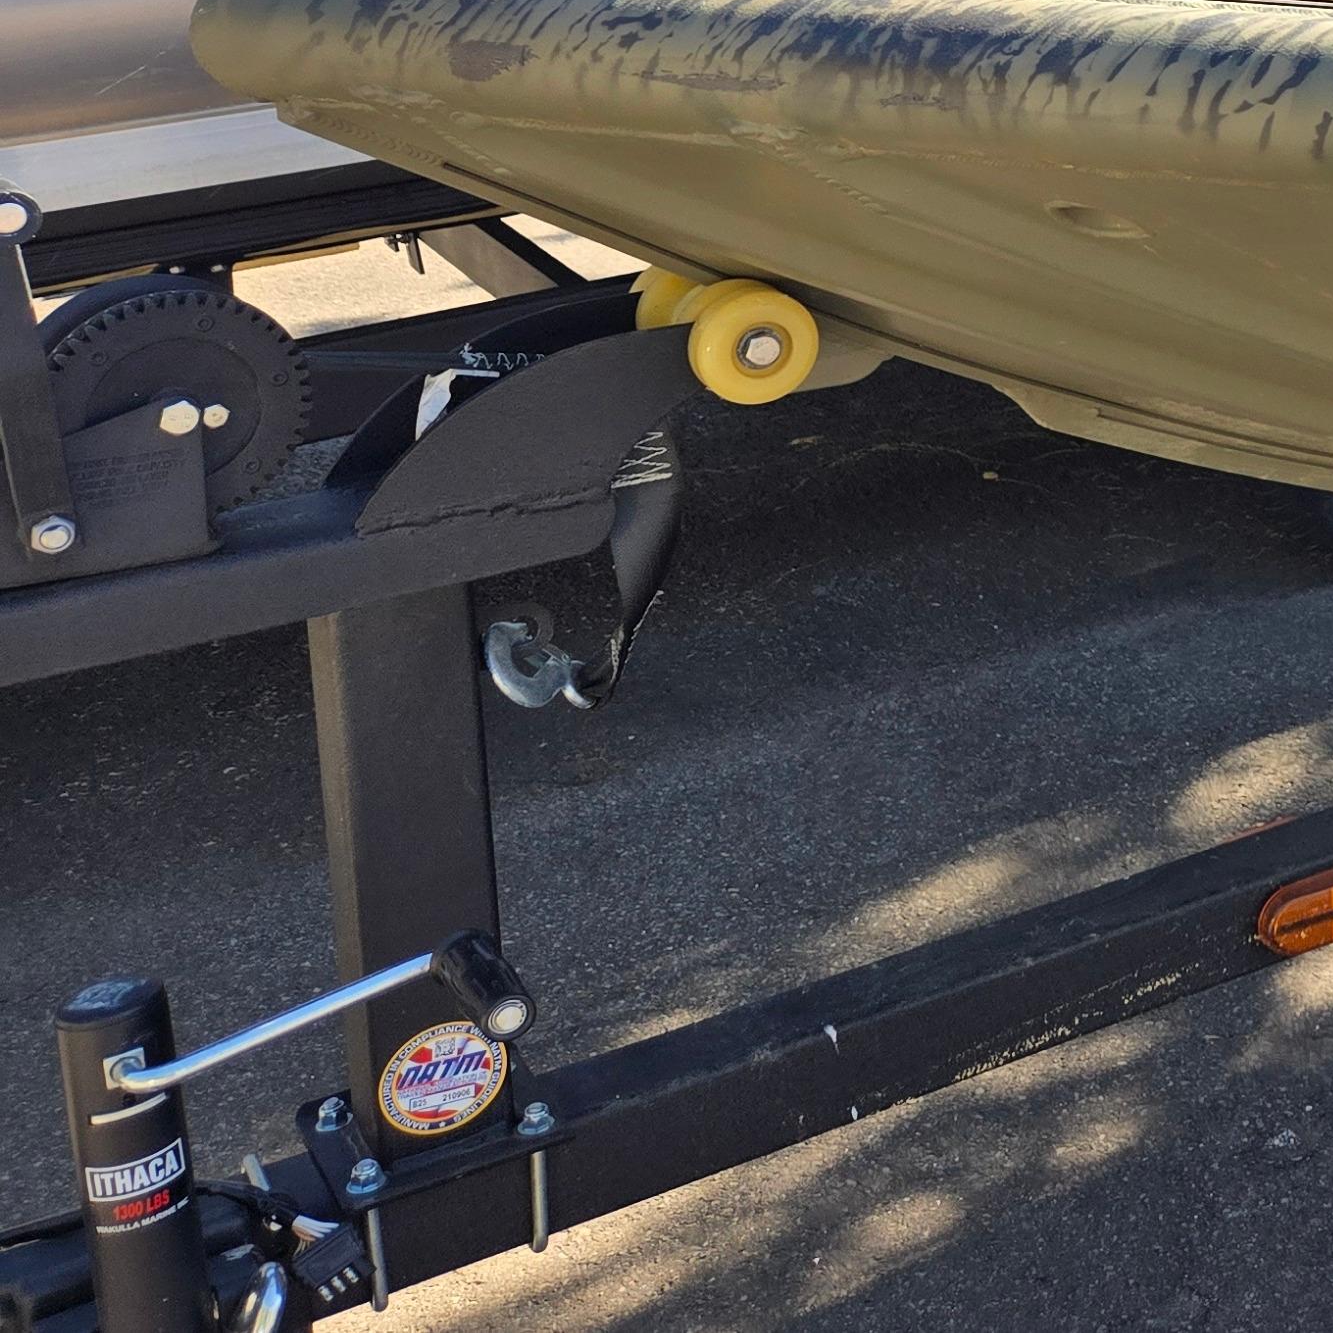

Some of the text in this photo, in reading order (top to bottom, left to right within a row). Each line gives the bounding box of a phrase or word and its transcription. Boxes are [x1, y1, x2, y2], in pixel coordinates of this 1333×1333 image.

[398, 1025, 467, 1059] COMPLIANCE
[93, 1149, 179, 1196] ITHACA
[113, 1188, 170, 1220] 1300 LBS
